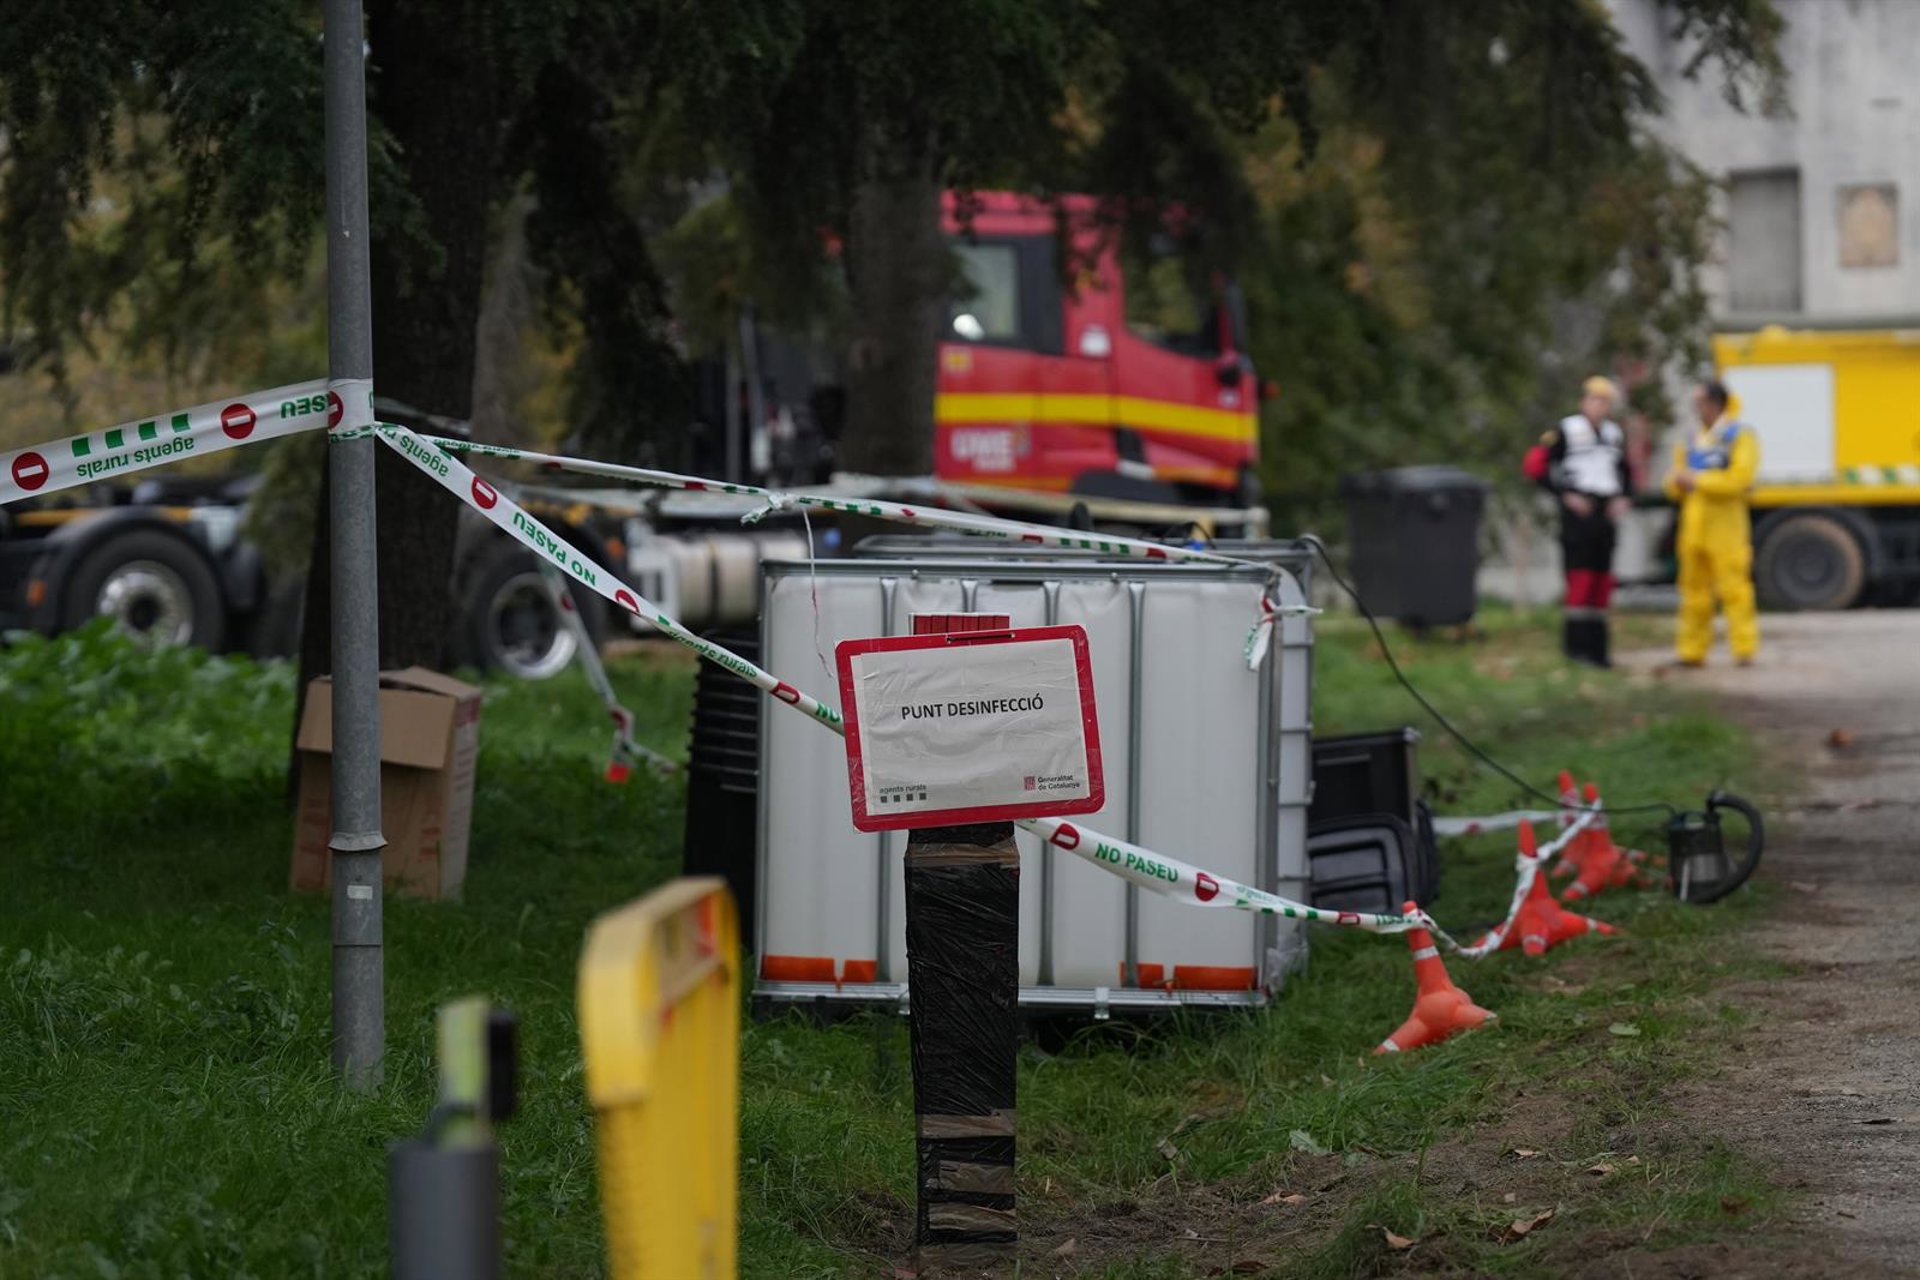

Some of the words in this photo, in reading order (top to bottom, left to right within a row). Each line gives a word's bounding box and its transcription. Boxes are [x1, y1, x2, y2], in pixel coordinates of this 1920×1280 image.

[280, 394, 328, 419] SEU
[134, 437, 194, 463] agents
[399, 435, 448, 477] agents
[76, 454, 129, 478] rurals
[512, 511, 567, 565] PASEU
[571, 559, 597, 587] NO
[901, 704, 943, 720] PUNT
[947, 693, 1044, 717] DESINFECCIÓ
[879, 786, 904, 794] agents
[905, 784, 927, 792] rurals
[1037, 775, 1073, 784] Generalitat
[1048, 781, 1081, 790] Catalunya
[1094, 842, 1121, 865] NO
[1125, 852, 1179, 883] PASEU
